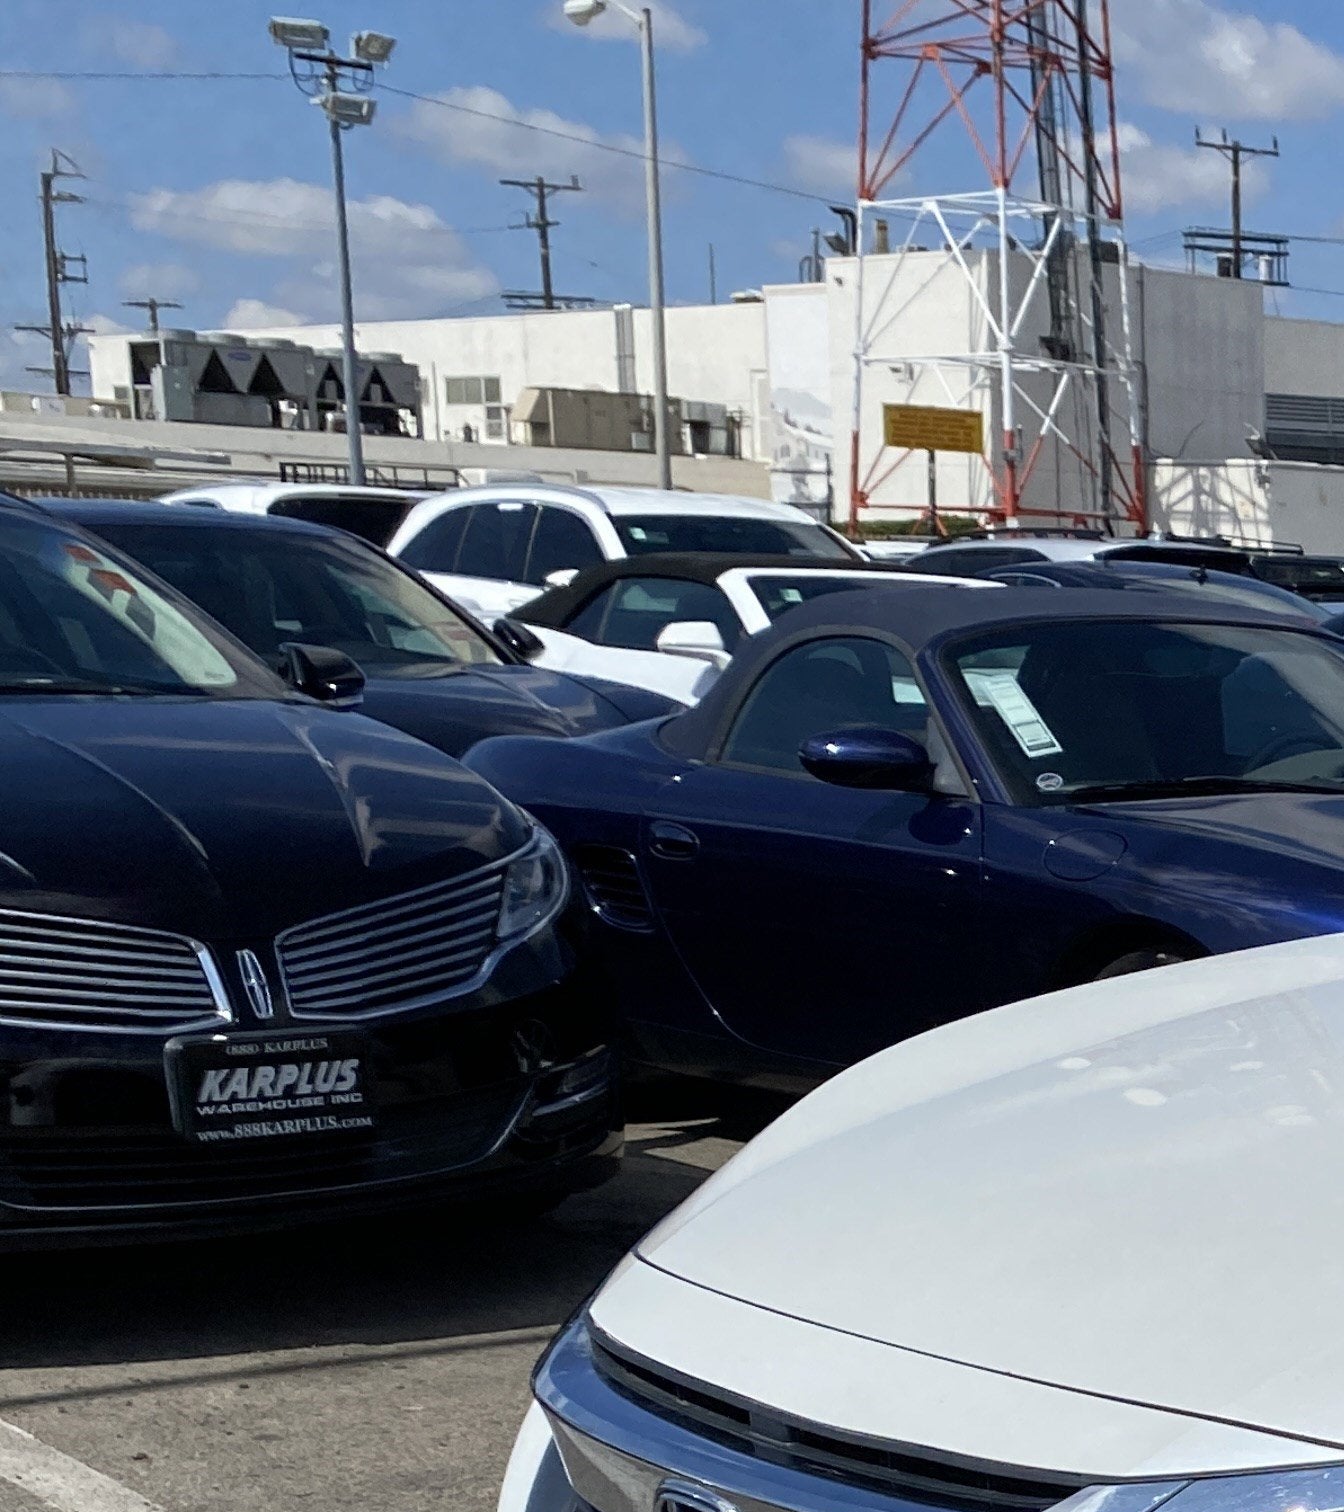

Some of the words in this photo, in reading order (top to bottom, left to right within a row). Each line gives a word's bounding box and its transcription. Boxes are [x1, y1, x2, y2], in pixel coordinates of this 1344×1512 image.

[264, 1037, 328, 1053] KARPLUS
[197, 1058, 360, 1104] KARPLUS
[196, 1096, 324, 1116] WAREHOUSE
[331, 1092, 364, 1105] INC
